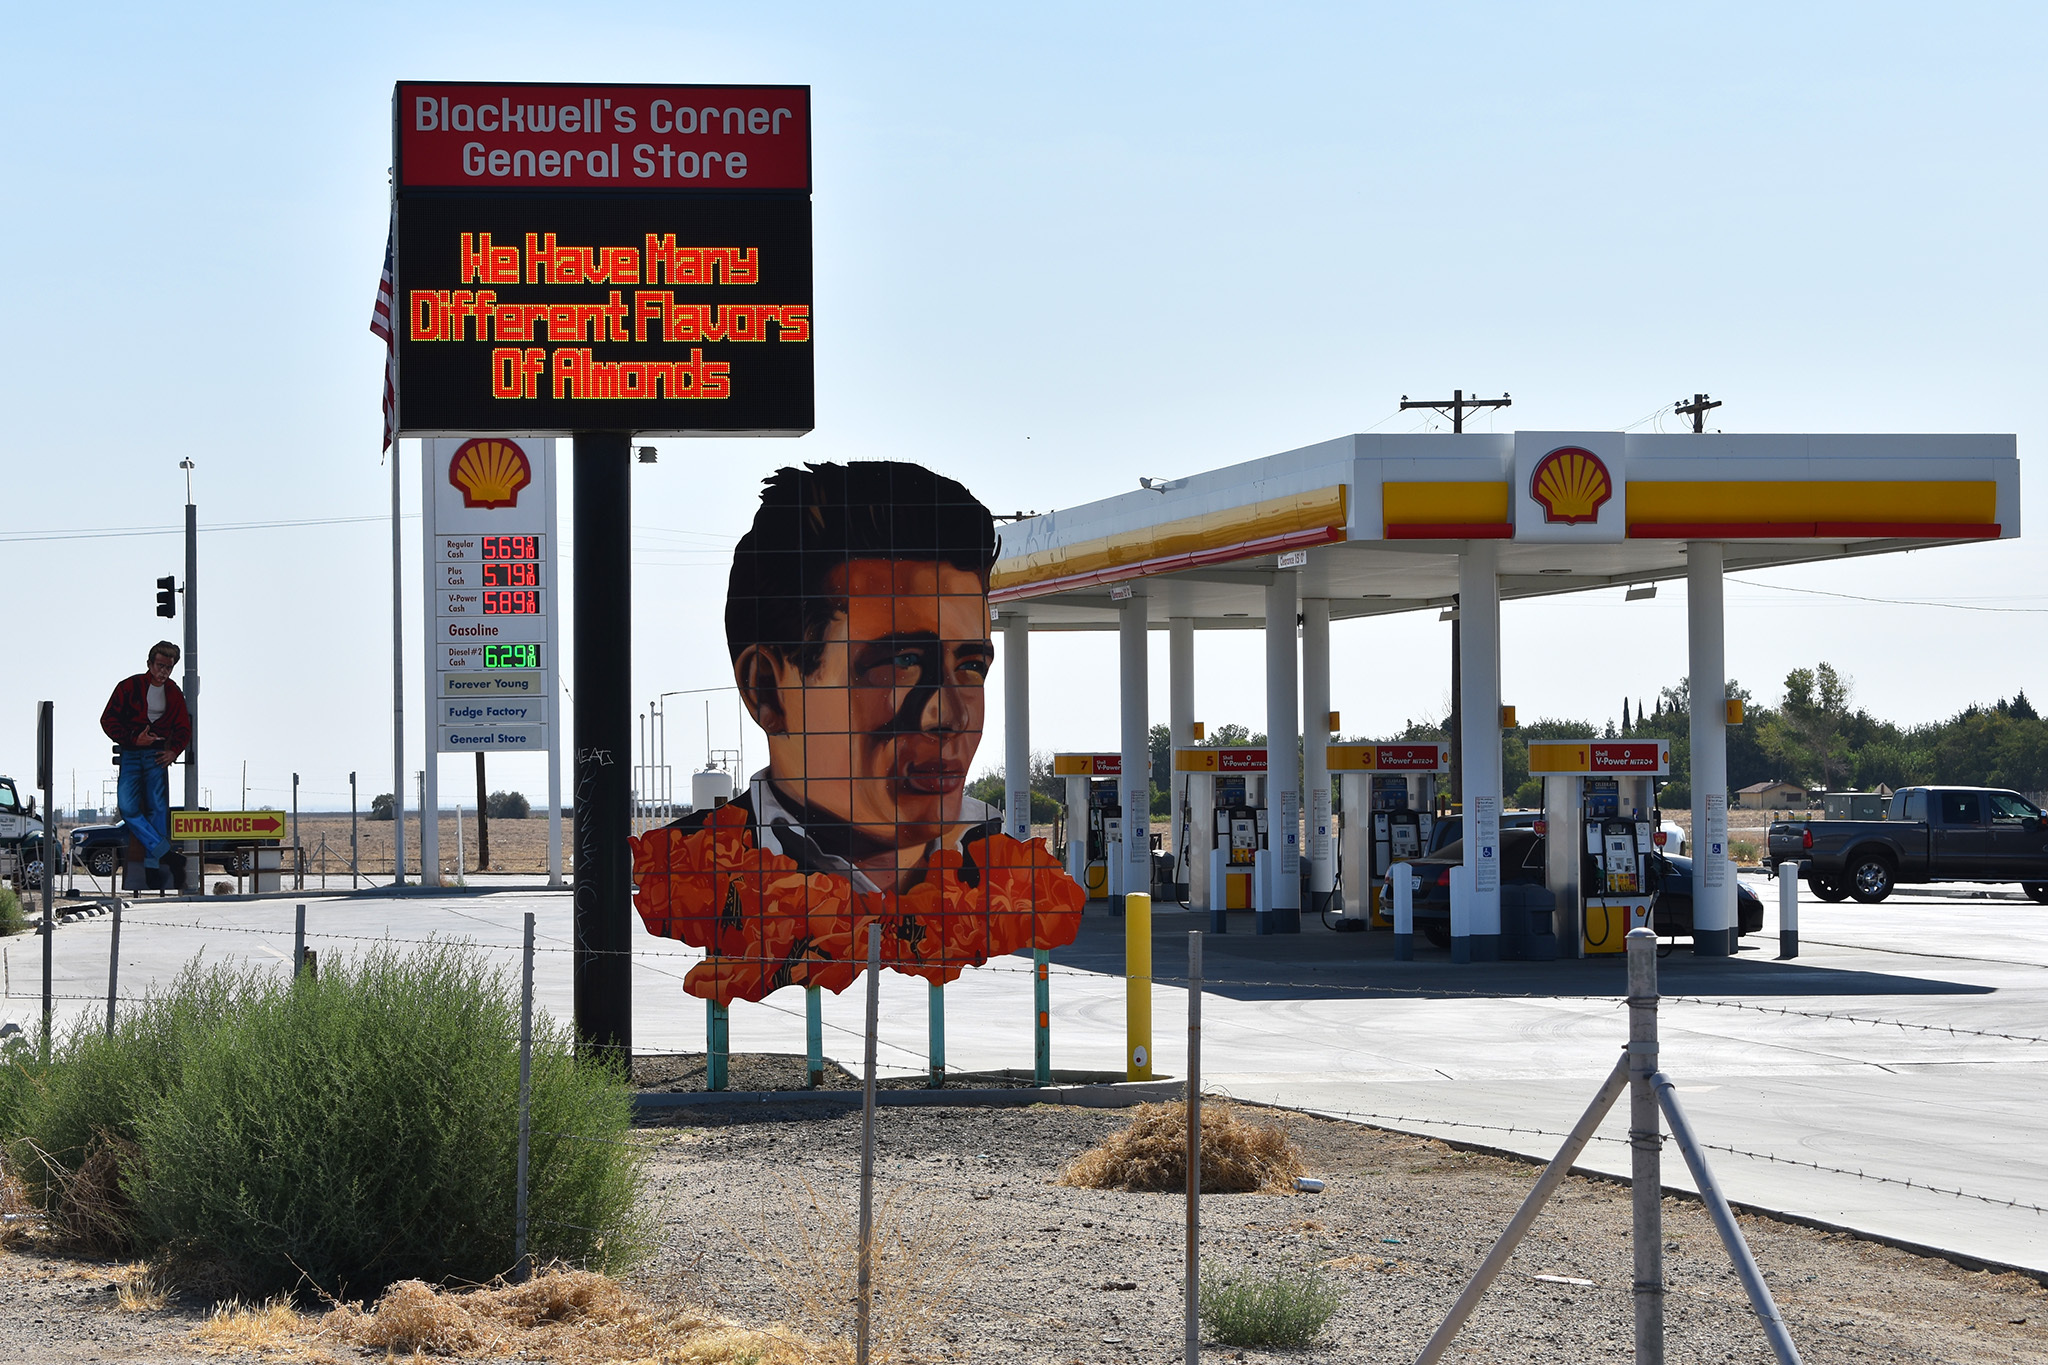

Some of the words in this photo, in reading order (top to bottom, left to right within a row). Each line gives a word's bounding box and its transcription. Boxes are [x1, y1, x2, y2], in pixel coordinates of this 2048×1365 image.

[415, 96, 637, 133] Blackwell's
[650, 99, 793, 135] Corner
[462, 141, 619, 178] General
[632, 143, 748, 179] Store
[461, 232, 519, 284] We
[526, 232, 639, 284] Have
[646, 233, 758, 285] Many
[410, 290, 629, 341] Different
[635, 290, 810, 342] Flavors
[492, 348, 546, 399] Of
[553, 348, 731, 399] Almonds
[447, 540, 474, 550] Regular
[447, 550, 465, 559] Cash
[447, 567, 463, 575] Plus
[448, 577, 465, 585] Cash
[448, 594, 477, 602] V-Power
[448, 604, 466, 613] Cash
[448, 623, 499, 636] Gasoline
[448, 648, 471, 656] Diesel
[449, 658, 466, 667] Cash
[449, 680, 491, 689] Forever
[494, 678, 529, 690] Young
[449, 706, 483, 719] Fudge
[486, 706, 528, 718] Factory
[449, 733, 494, 744] General
[498, 733, 527, 743] Store
[1206, 755, 1214, 766] 5
[1362, 752, 1371, 765] 3
[1578, 751, 1585, 765] 1
[1595, 757, 1628, 765] V-Power
[1080, 760, 1088, 770] 7
[174, 818, 252, 833] ENTRANCE
